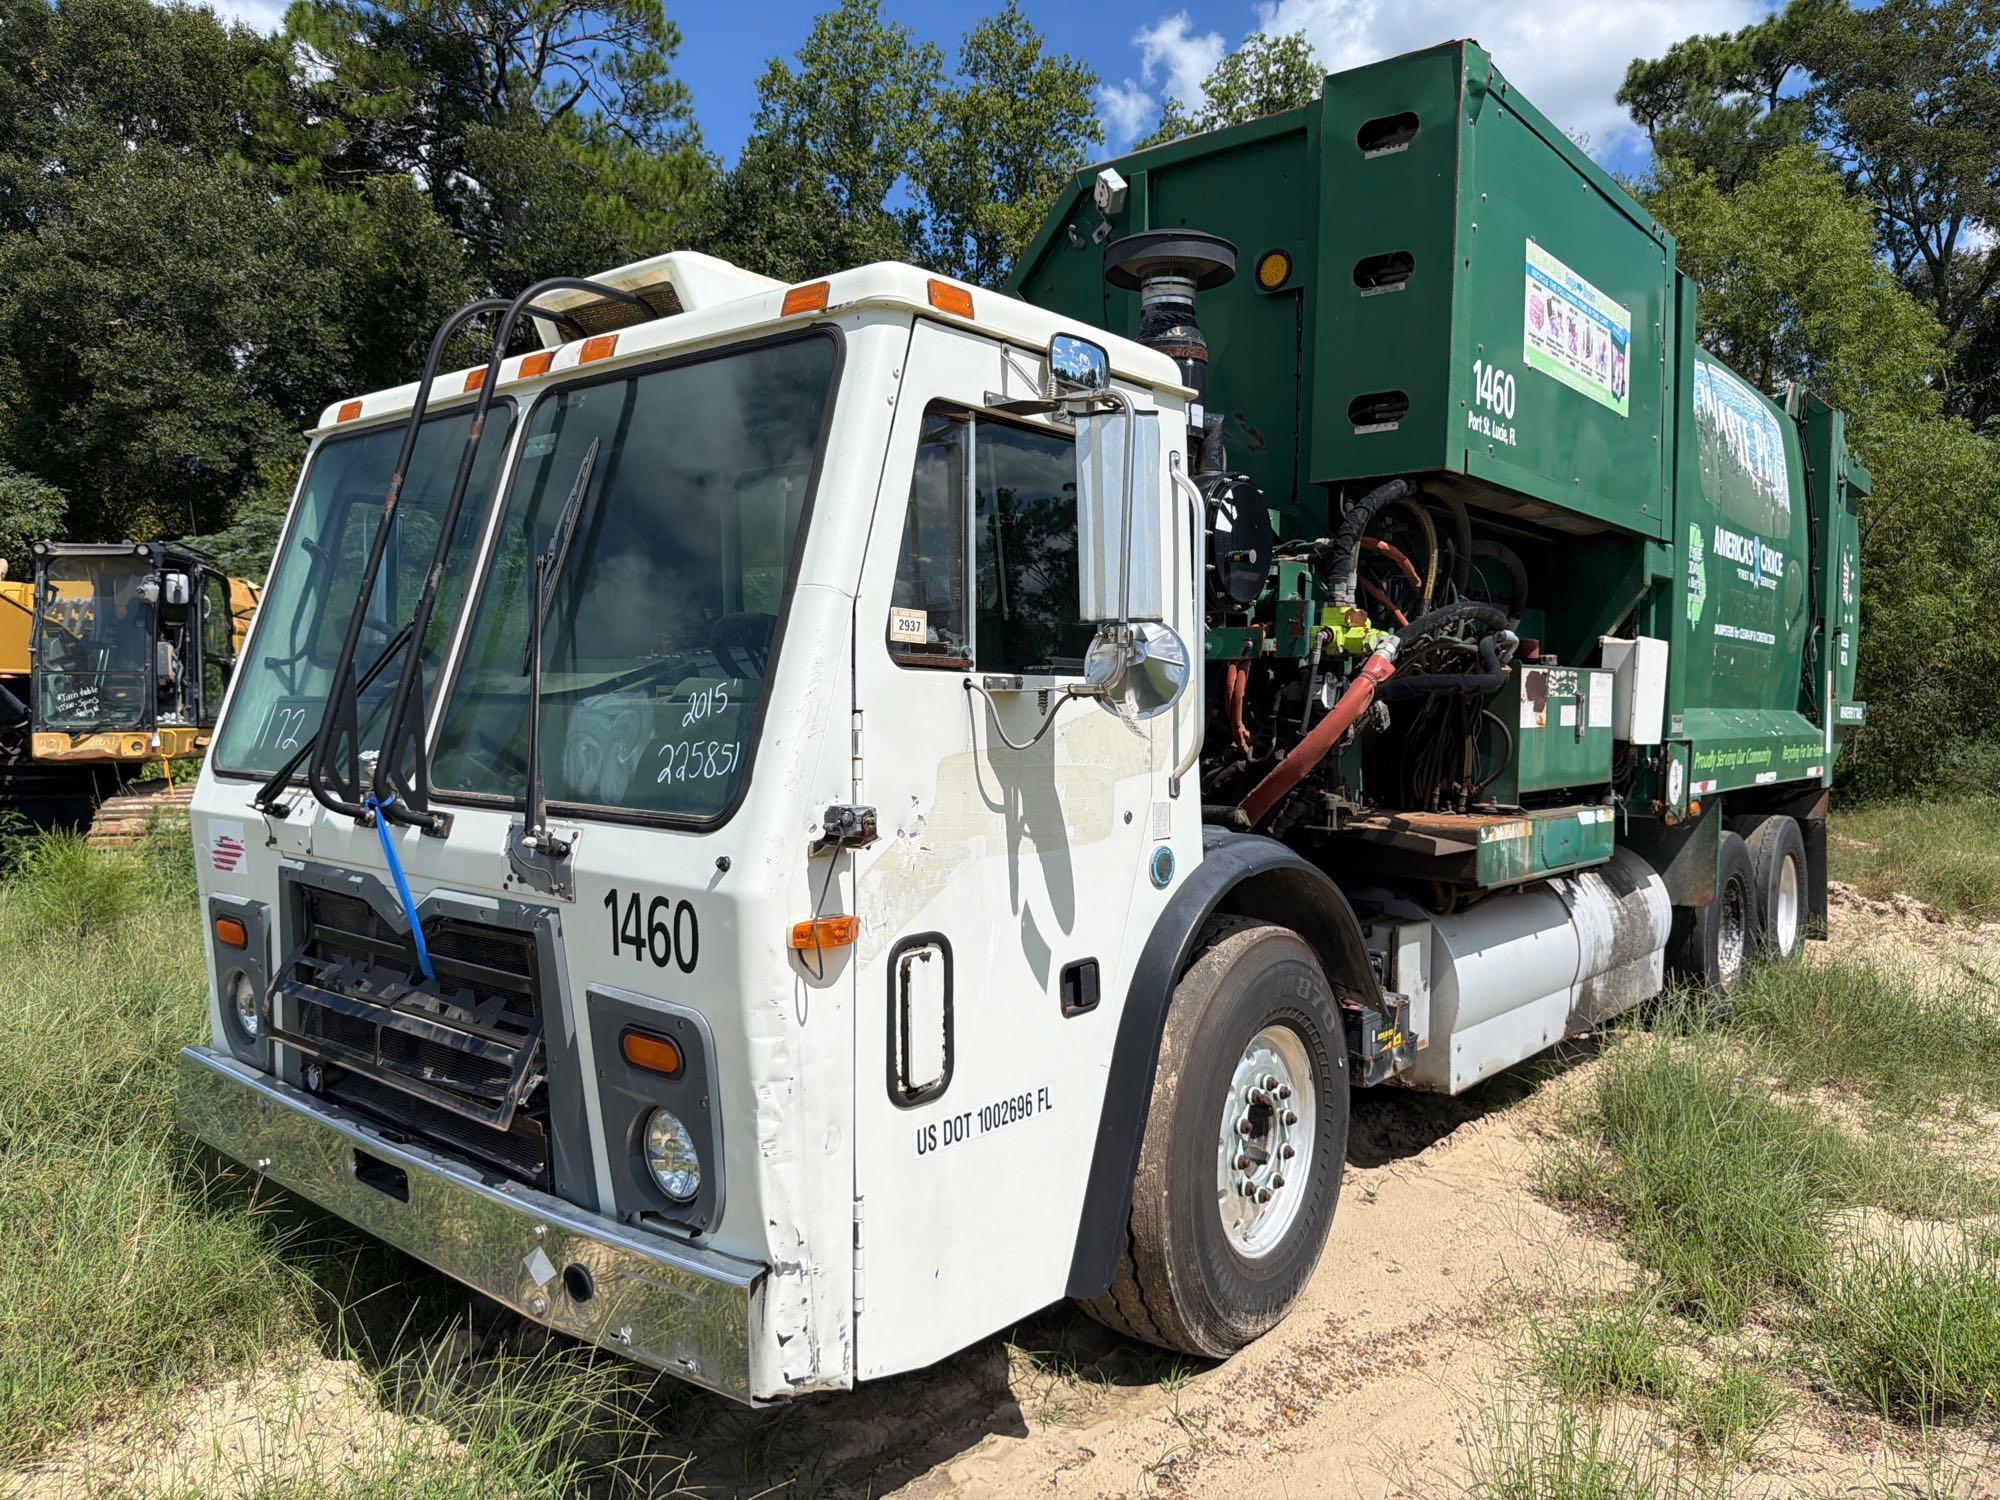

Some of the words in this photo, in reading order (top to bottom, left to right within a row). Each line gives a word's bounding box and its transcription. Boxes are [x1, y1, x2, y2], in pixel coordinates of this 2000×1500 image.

[1473, 359, 1516, 420] 1460
[1468, 410, 1482, 433] Port
[1483, 416, 1491, 437] St.
[1492, 420, 1509, 446] Lucie,
[1509, 427, 1517, 447] FL
[1713, 525, 1754, 567] AMERICA'S
[1760, 543, 1783, 578] CHOICE
[899, 619, 921, 632] 2937
[657, 741, 740, 784] 225851
[1694, 749, 1715, 772] Proudly
[1716, 749, 1736, 770] Serving
[1736, 748, 1747, 766] Our
[1747, 746, 1772, 767] Community
[1782, 744, 1800, 763] Recycling
[604, 888, 699, 974] 1460
[917, 1123, 937, 1155] US
[943, 1111, 972, 1147] DOT
[977, 1092, 1033, 1134] 1002696
[1037, 1086, 1052, 1113] FL
